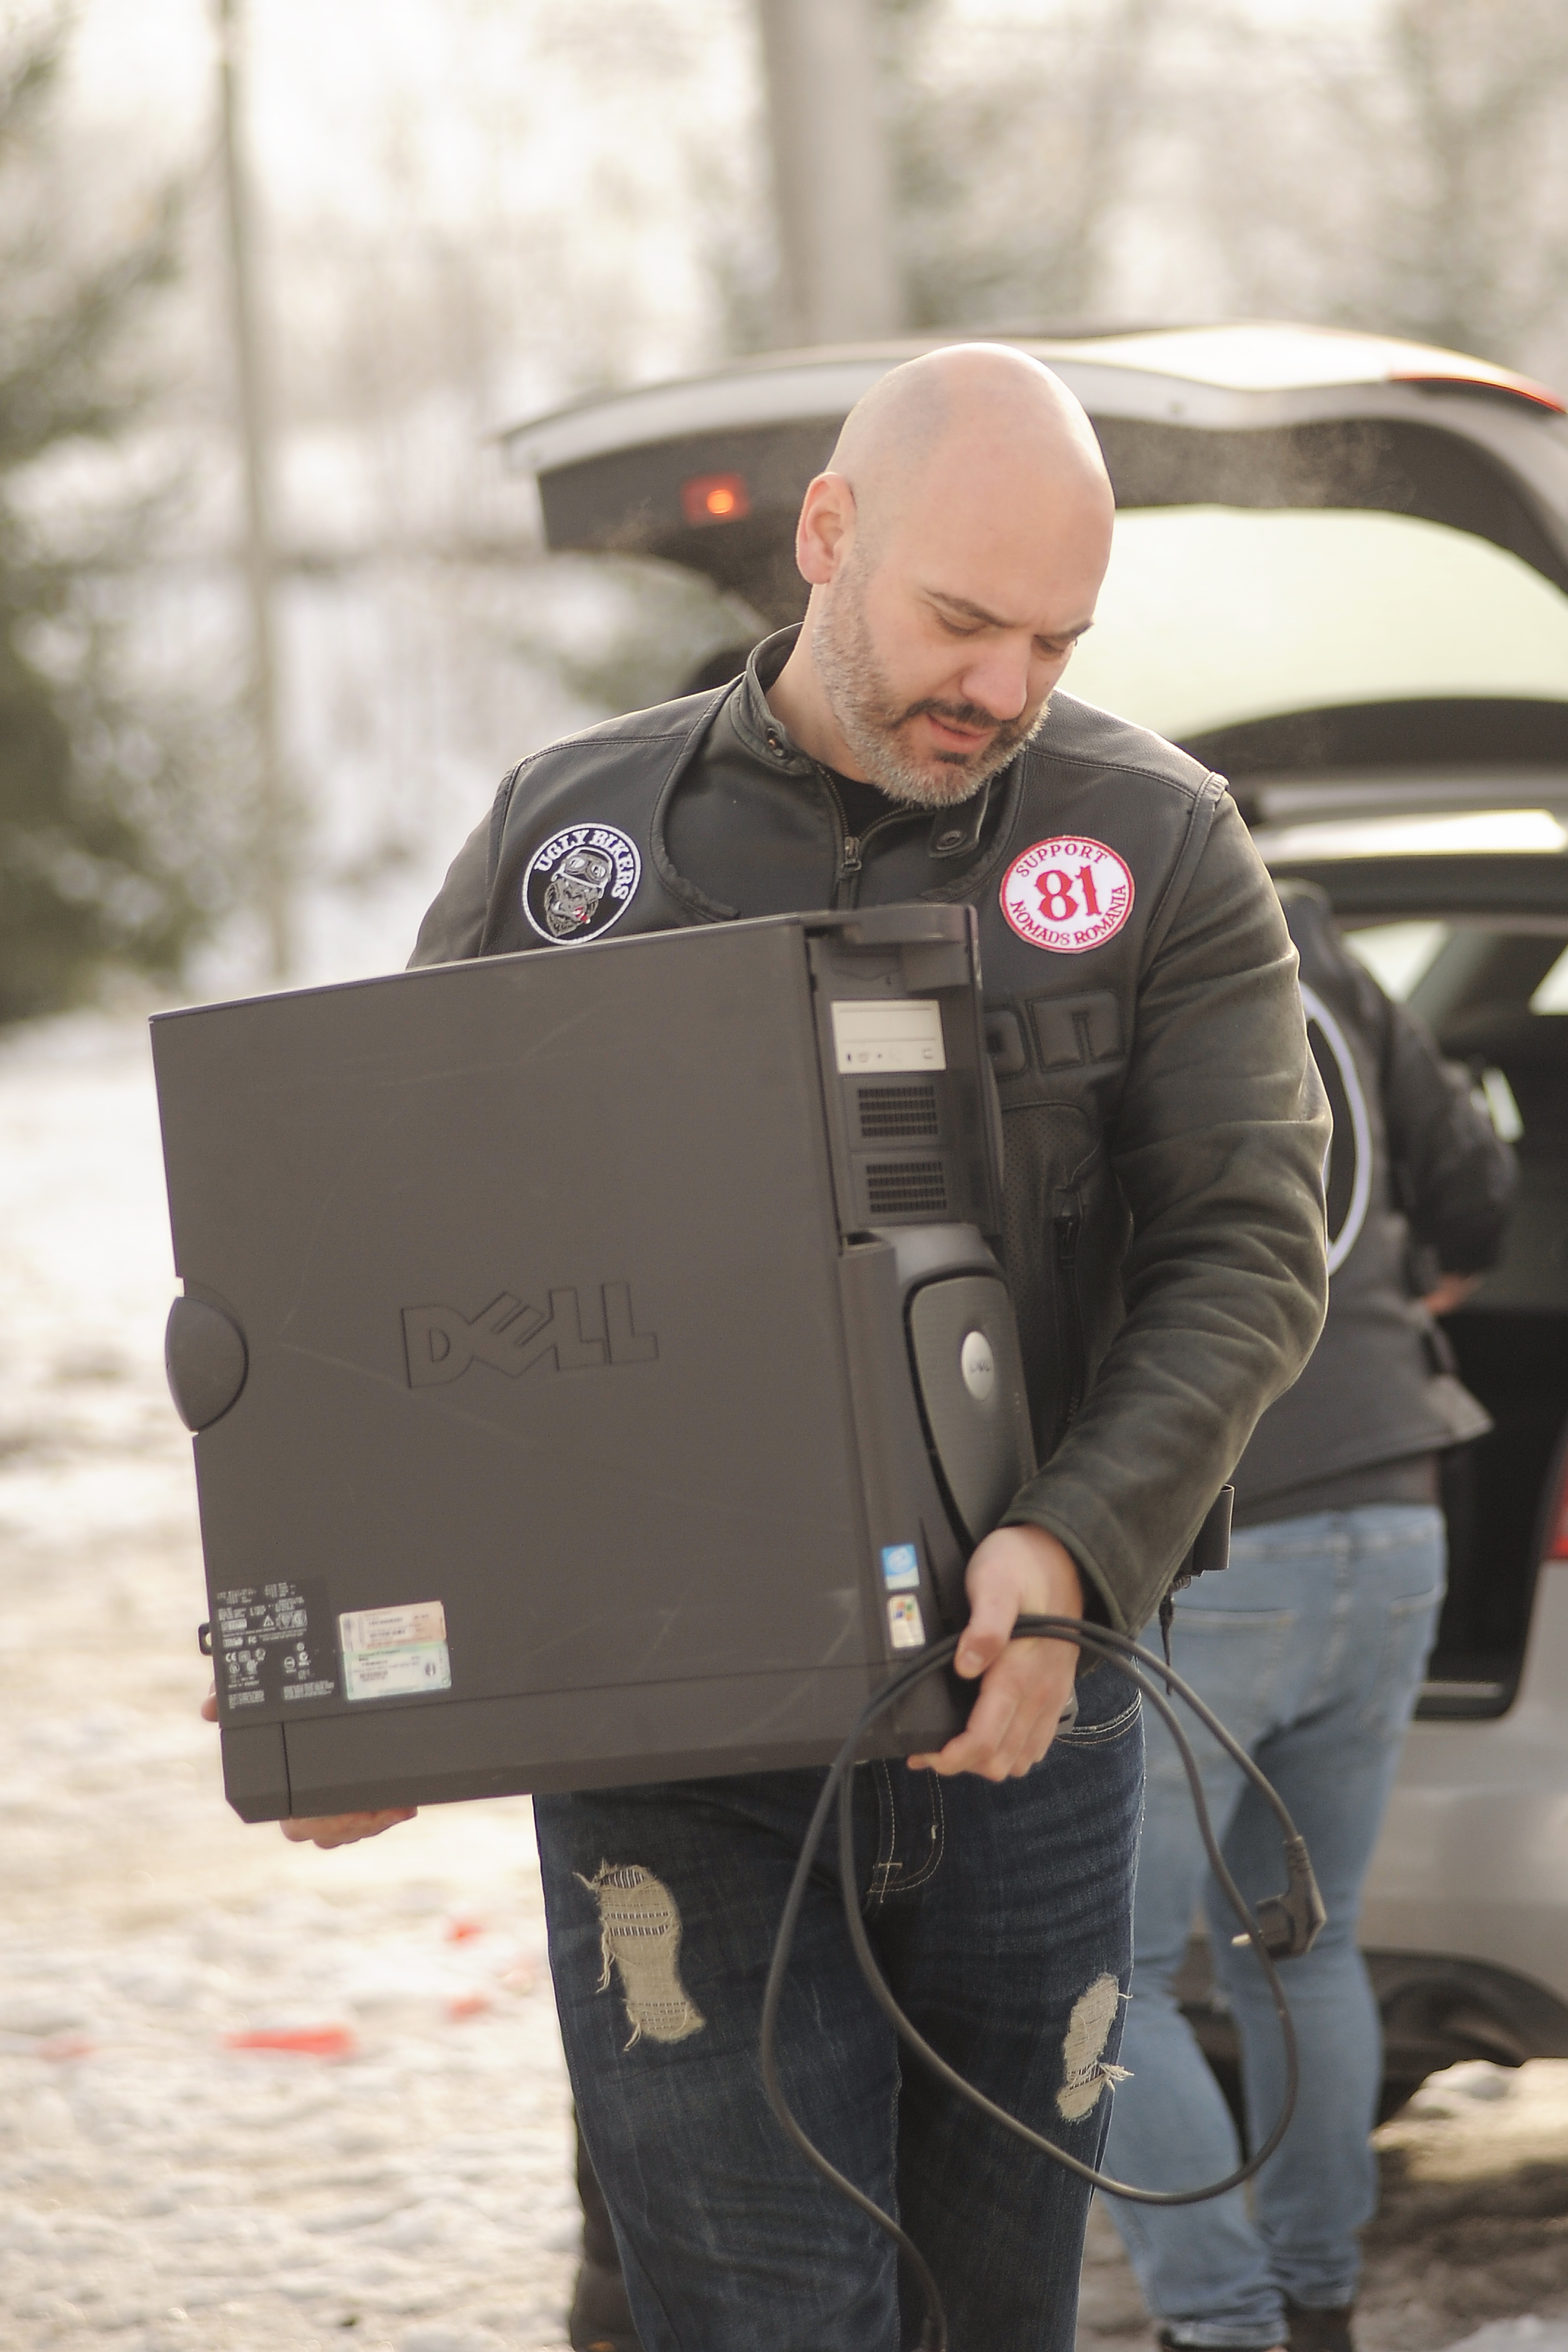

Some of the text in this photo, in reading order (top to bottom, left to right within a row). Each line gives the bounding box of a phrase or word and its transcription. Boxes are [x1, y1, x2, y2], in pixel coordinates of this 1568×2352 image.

[534, 829, 635, 900] UGLY BIKERS
[1016, 843, 1109, 878] SUPPORT
[1010, 885, 1126, 946] NOMADS ROMANIA
[1034, 864, 1102, 922] 81
[401, 1281, 659, 1389] DELL
